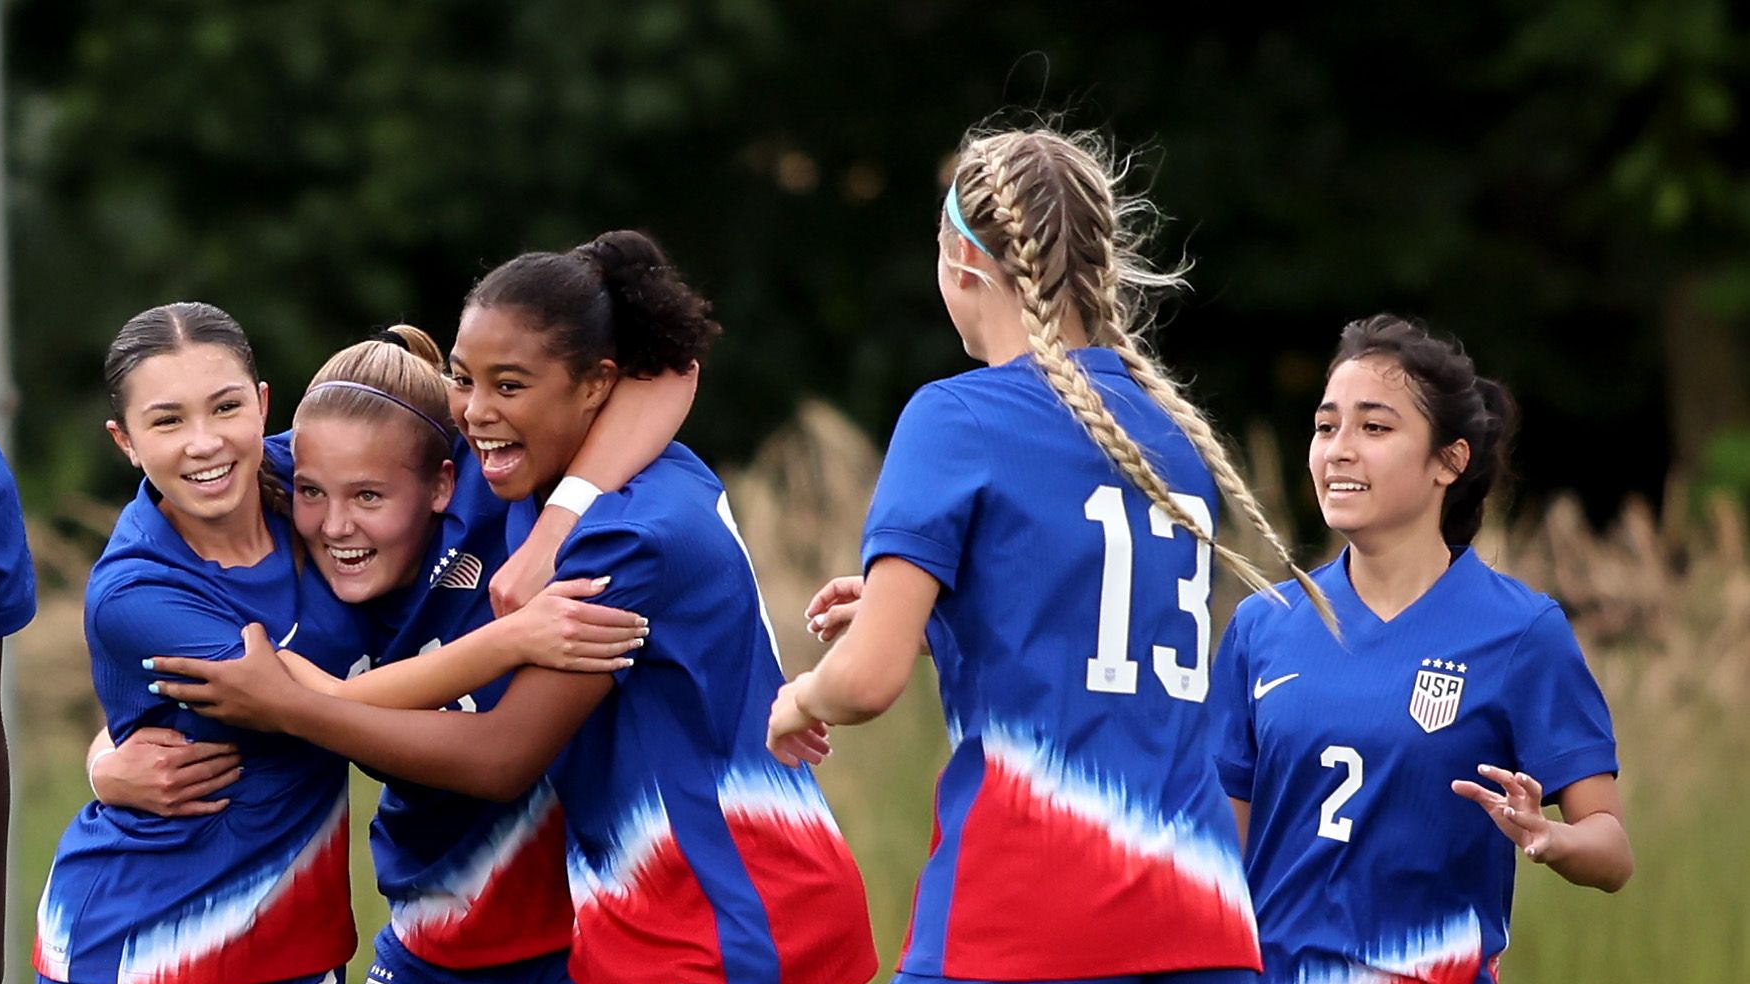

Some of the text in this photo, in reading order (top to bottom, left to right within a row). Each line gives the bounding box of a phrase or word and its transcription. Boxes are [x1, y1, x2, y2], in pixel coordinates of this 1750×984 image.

[1084, 484, 1214, 704] 13
[1418, 674, 1460, 699] USA
[1317, 745, 1364, 843] 2
